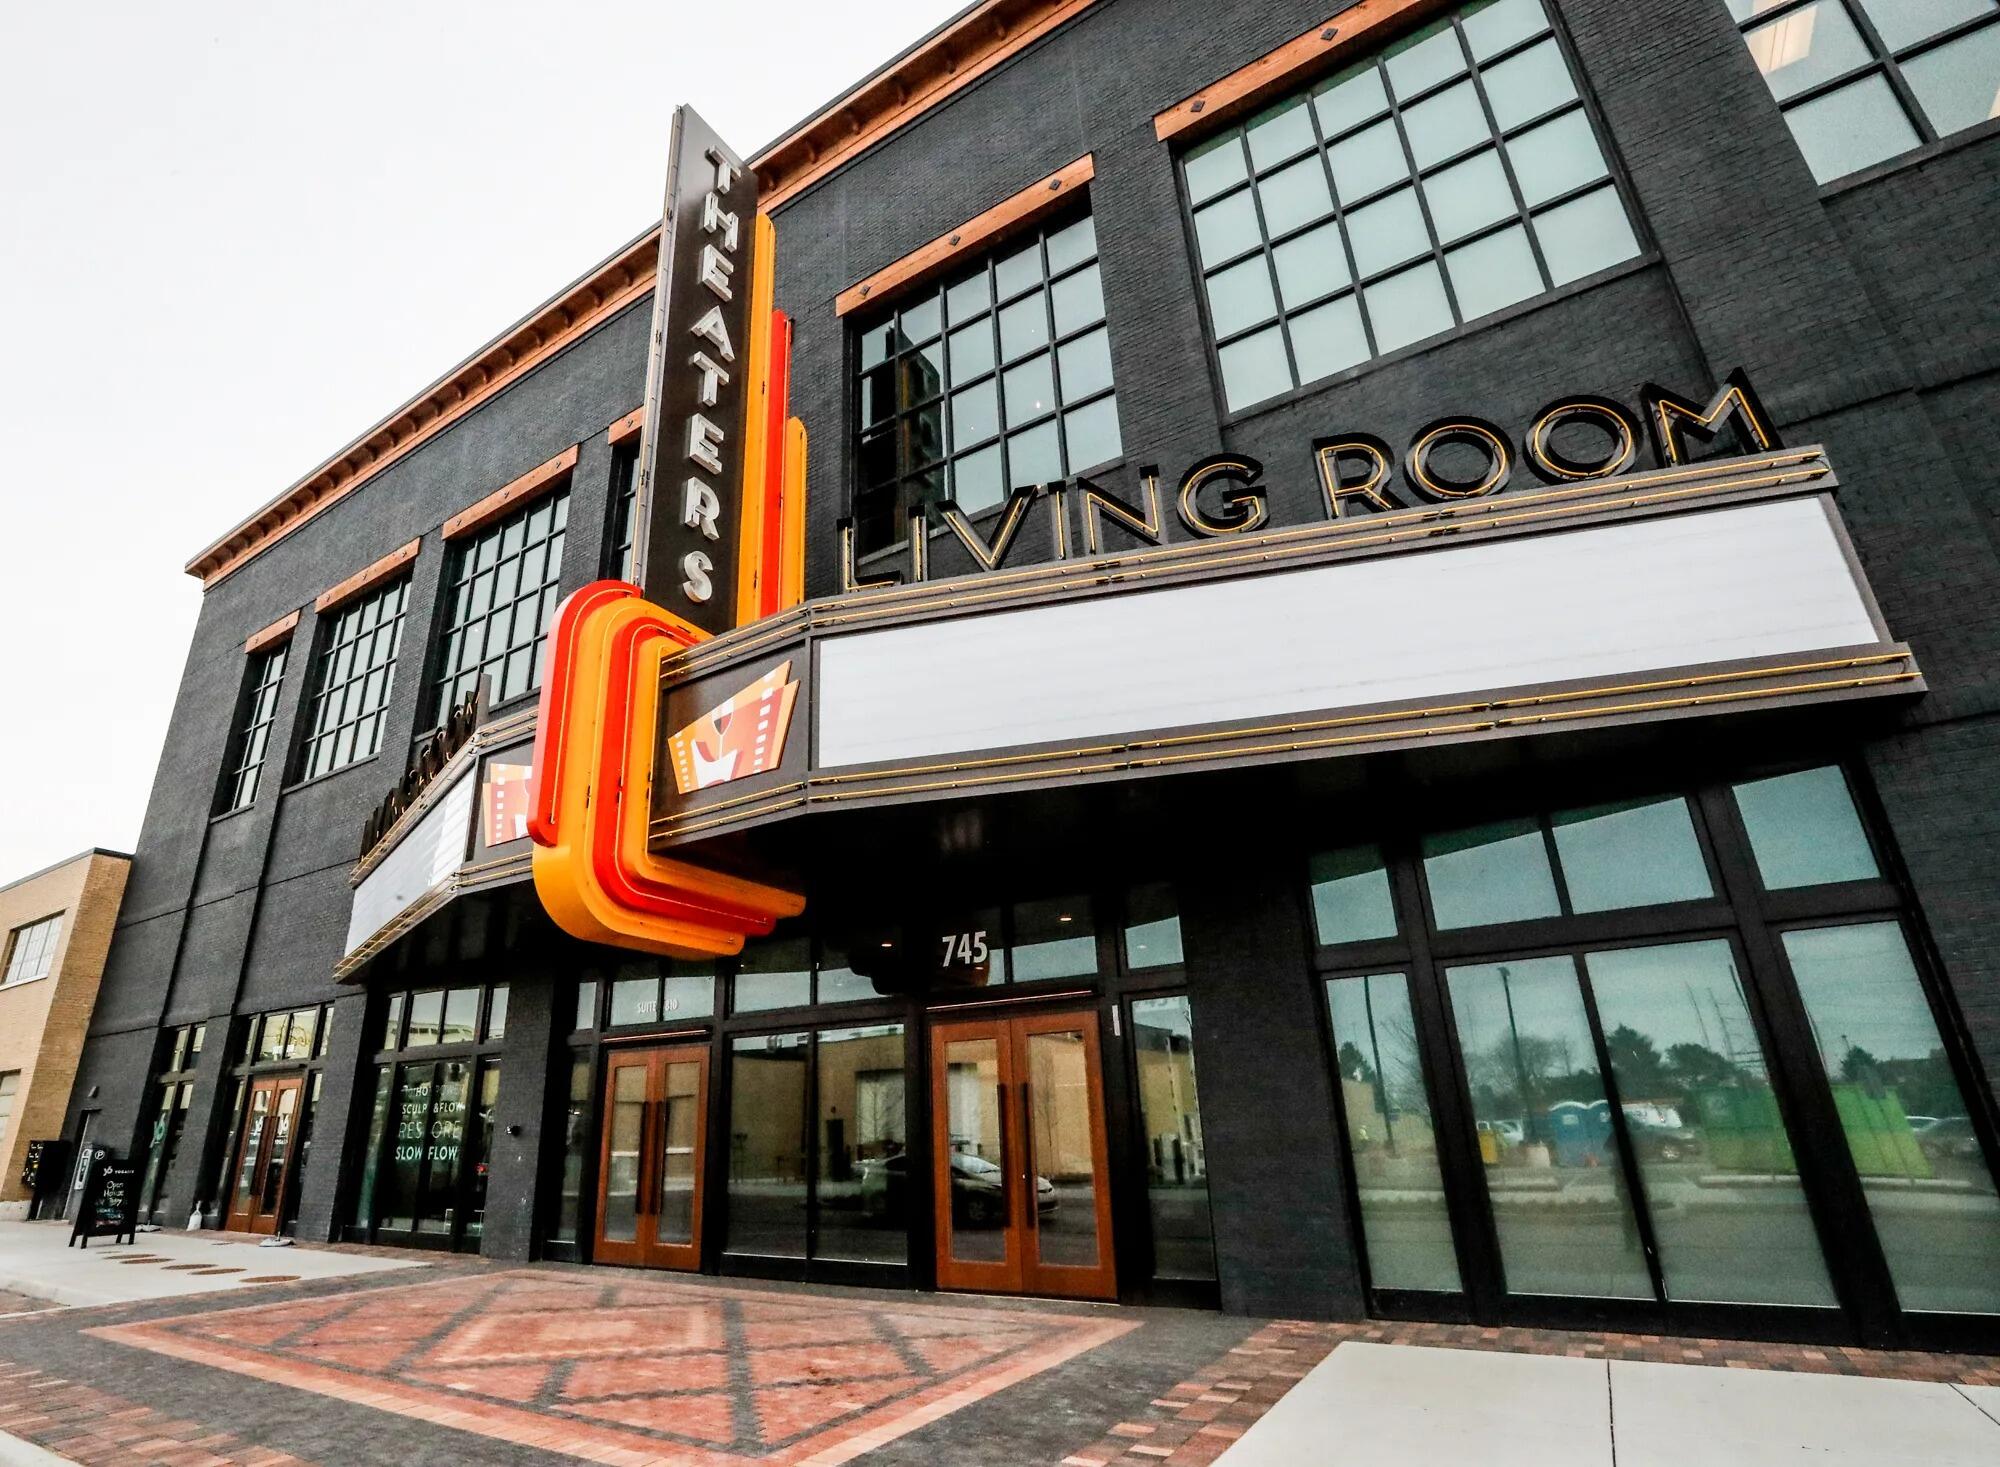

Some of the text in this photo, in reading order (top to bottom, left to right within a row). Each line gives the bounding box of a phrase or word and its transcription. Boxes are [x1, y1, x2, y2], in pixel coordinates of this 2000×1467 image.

[682, 143, 742, 603] THEATERS
[836, 366, 1785, 595] LIVING ROOM
[942, 930, 988, 967] 745
[637, 1000, 657, 1014] SUITE
[401, 1102, 429, 1115] SCULP
[395, 1145, 458, 1161] SLOW FLOW
